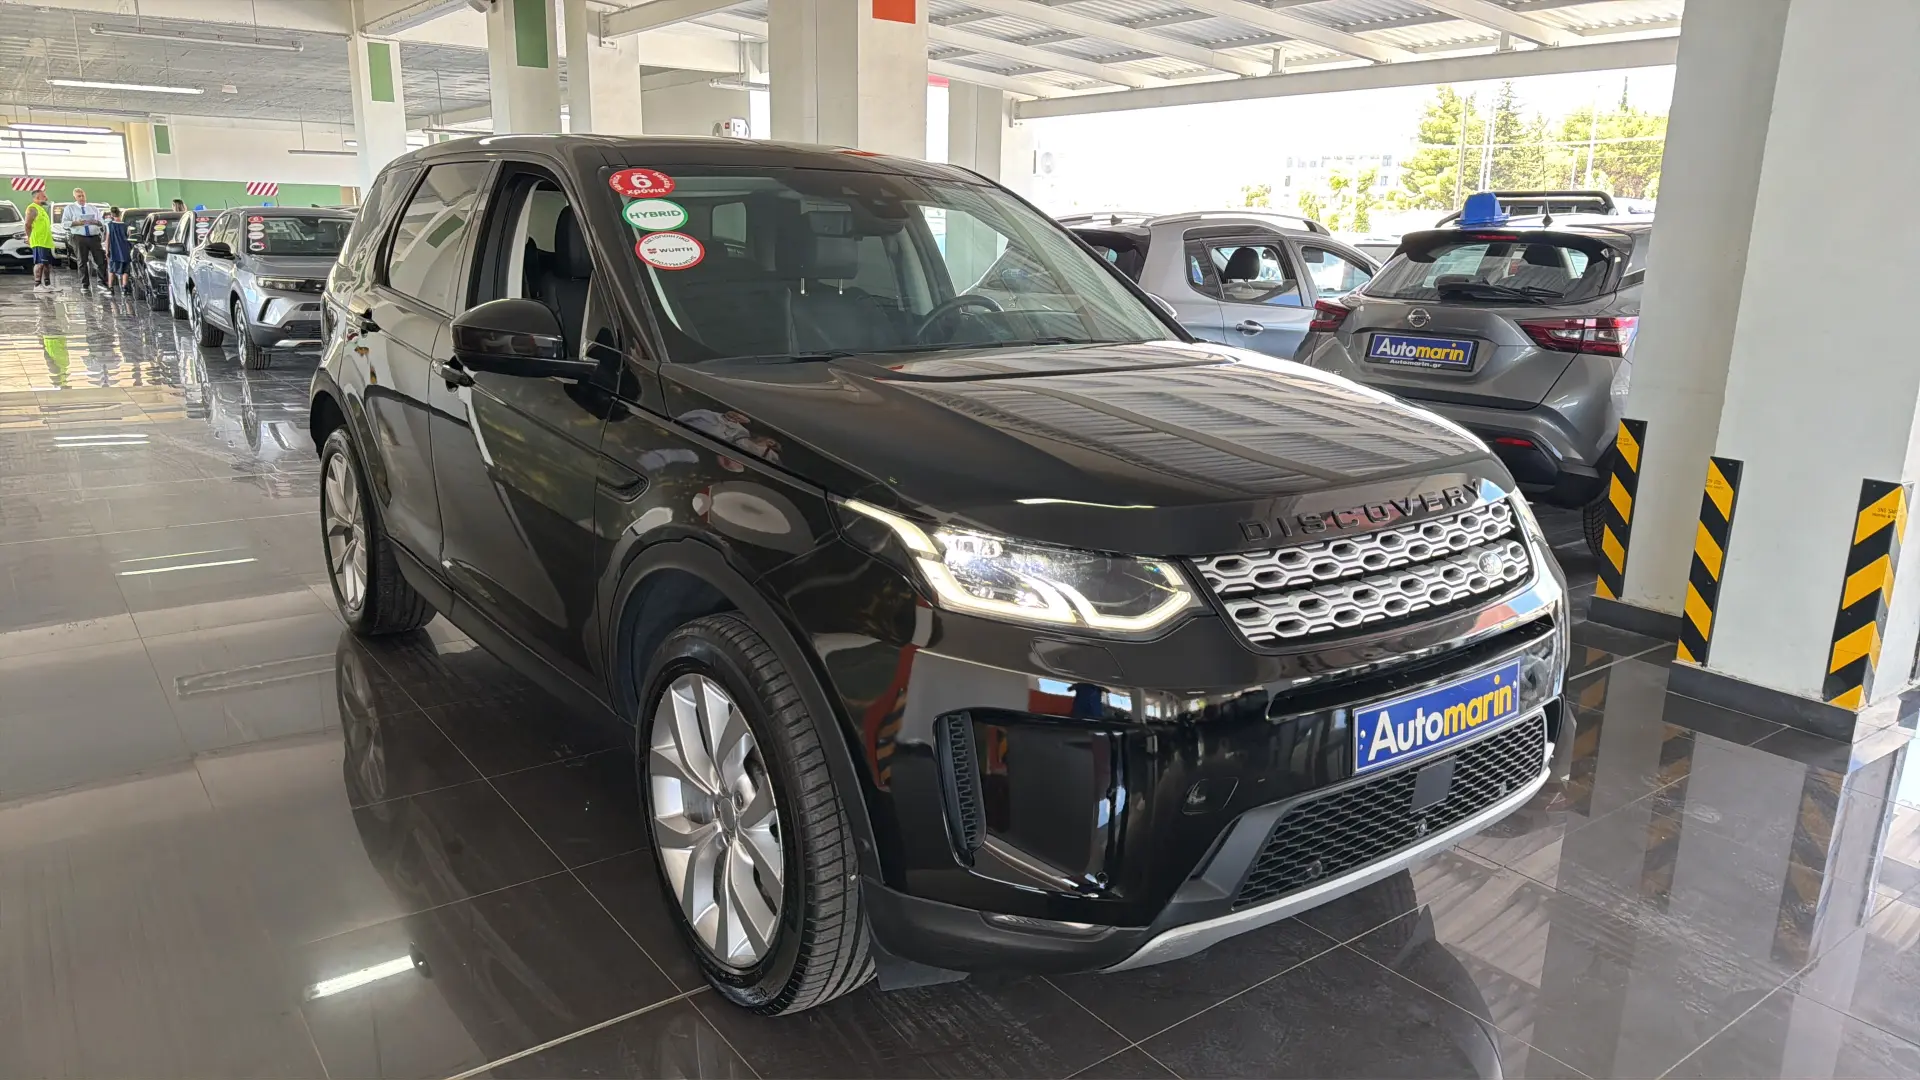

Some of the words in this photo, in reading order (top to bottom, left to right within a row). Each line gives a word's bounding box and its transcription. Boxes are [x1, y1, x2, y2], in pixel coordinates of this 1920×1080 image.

[631, 174, 652, 188] 6
[629, 210, 681, 219] HYBRID
[1376, 338, 1465, 361] Automarin
[1389, 359, 1442, 368] Automarin.gr
[1237, 479, 1481, 542] DISCOVERY
[1367, 674, 1512, 761] Automarin
